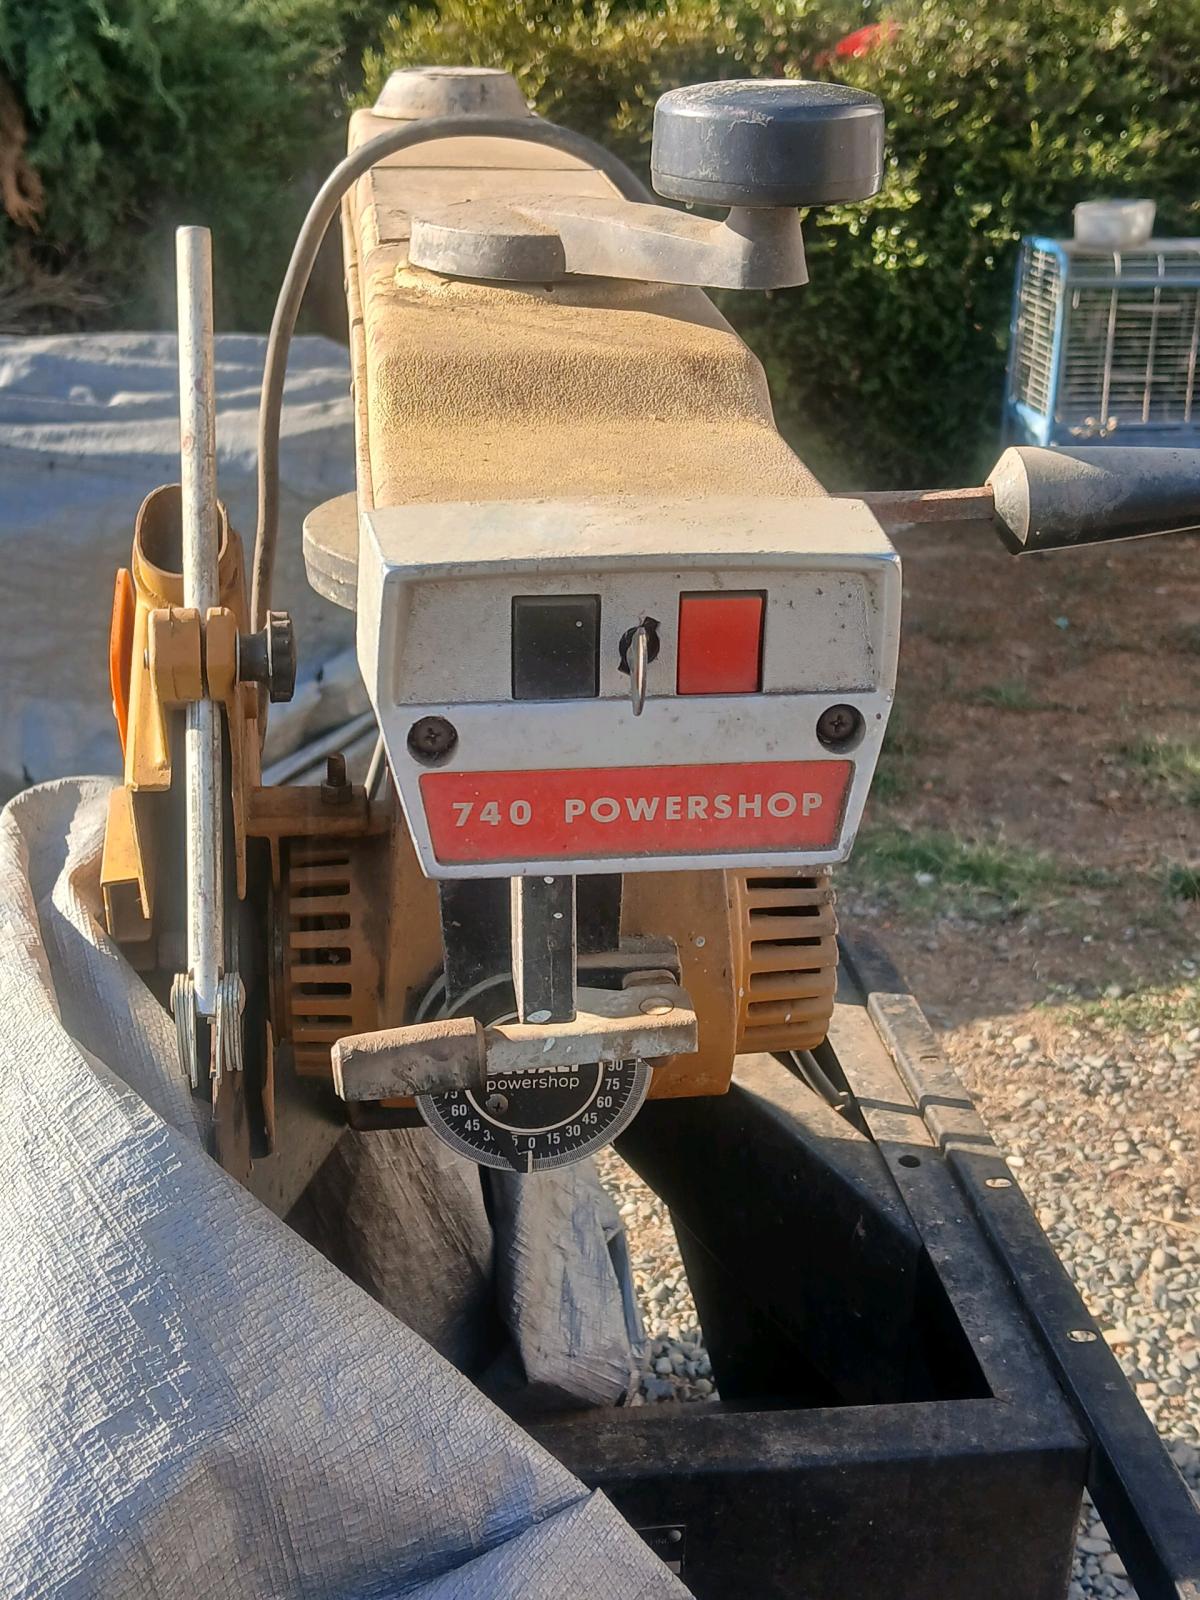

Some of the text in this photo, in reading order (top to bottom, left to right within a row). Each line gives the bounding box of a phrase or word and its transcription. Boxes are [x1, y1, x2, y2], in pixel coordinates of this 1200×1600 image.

[452, 791, 823, 827] 740 POWERSHOP
[486, 1075, 580, 1092] powershop
[606, 1078, 620, 1090] 75
[596, 1096, 612, 1108] 60
[451, 1104, 468, 1116] 60
[581, 1113, 598, 1124] 45
[464, 1119, 480, 1131] 45
[565, 1125, 581, 1137] 30
[483, 1130, 496, 1142] 3
[547, 1133, 560, 1144] 15
[528, 1137, 536, 1149] 0
